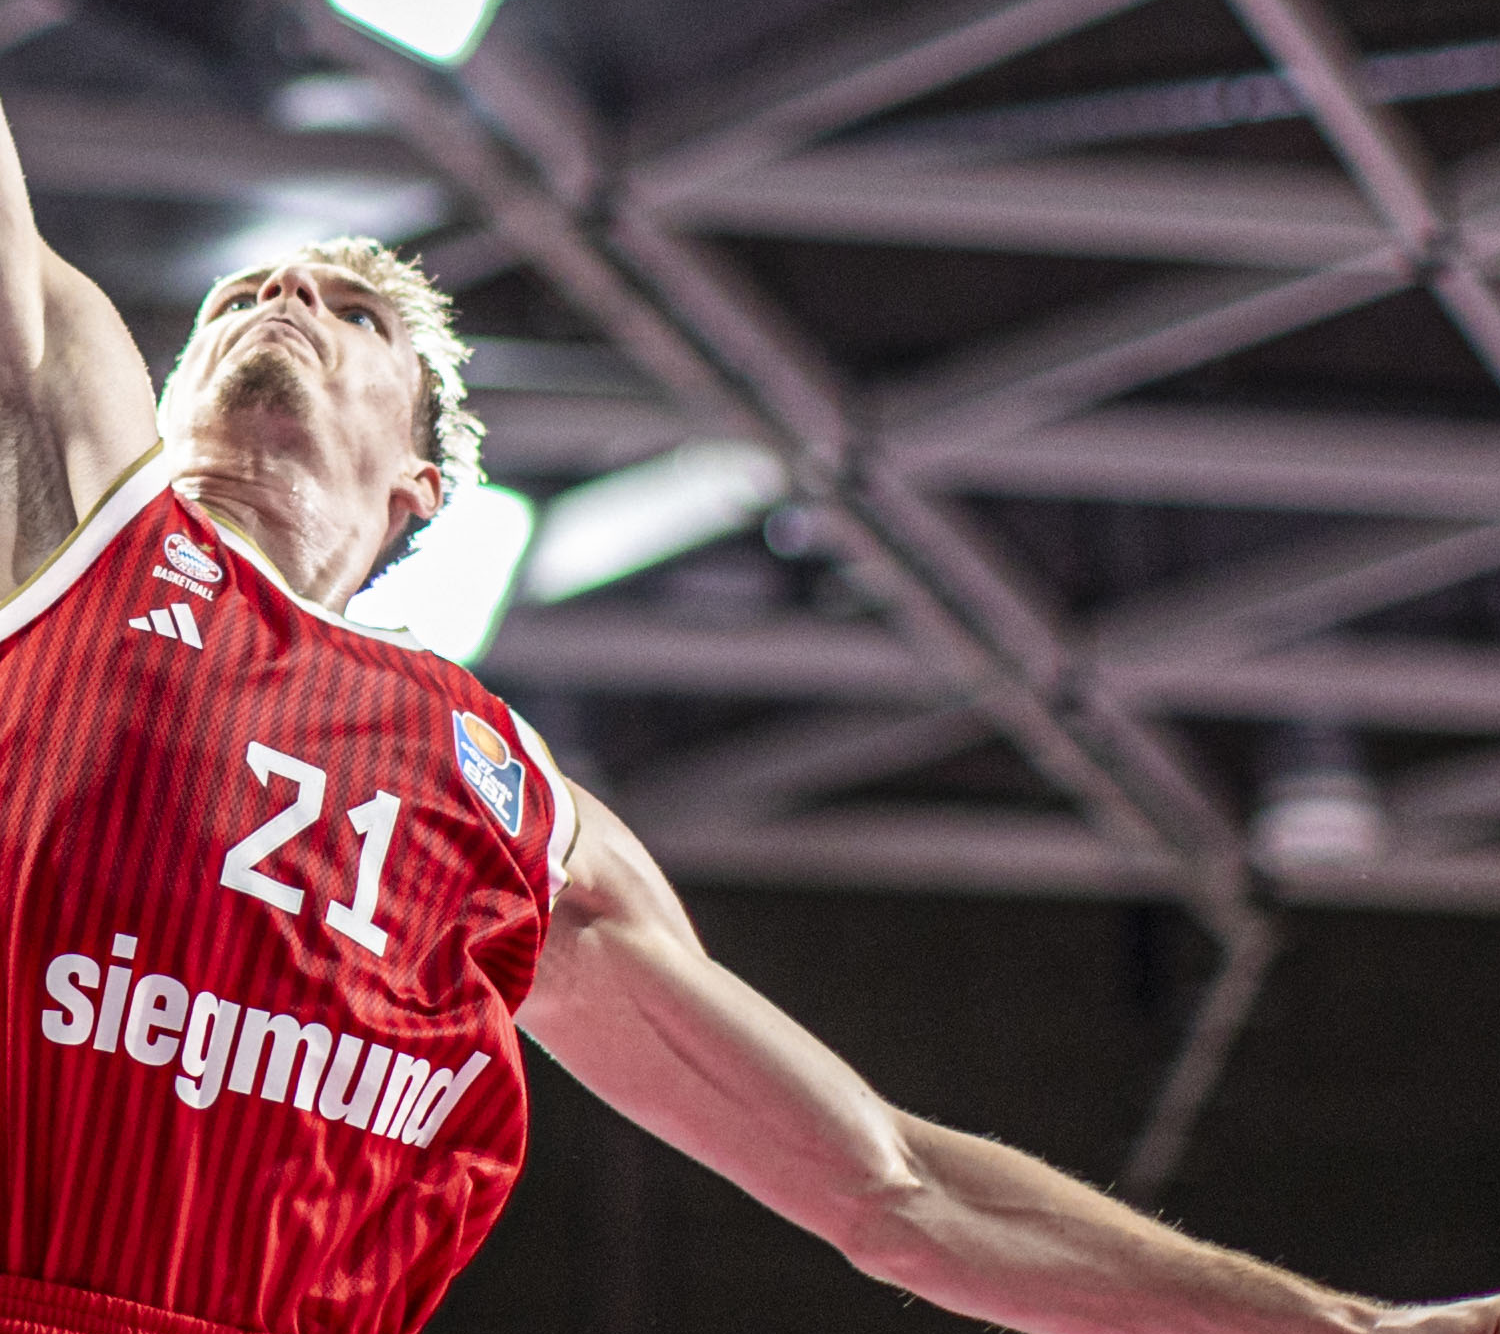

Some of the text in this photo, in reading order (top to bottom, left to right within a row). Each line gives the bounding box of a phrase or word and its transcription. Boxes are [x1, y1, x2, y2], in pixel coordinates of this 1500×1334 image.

[152, 565, 214, 602] BASKETBALL
[220, 741, 400, 957] 21
[42, 933, 491, 1149] siegmund
